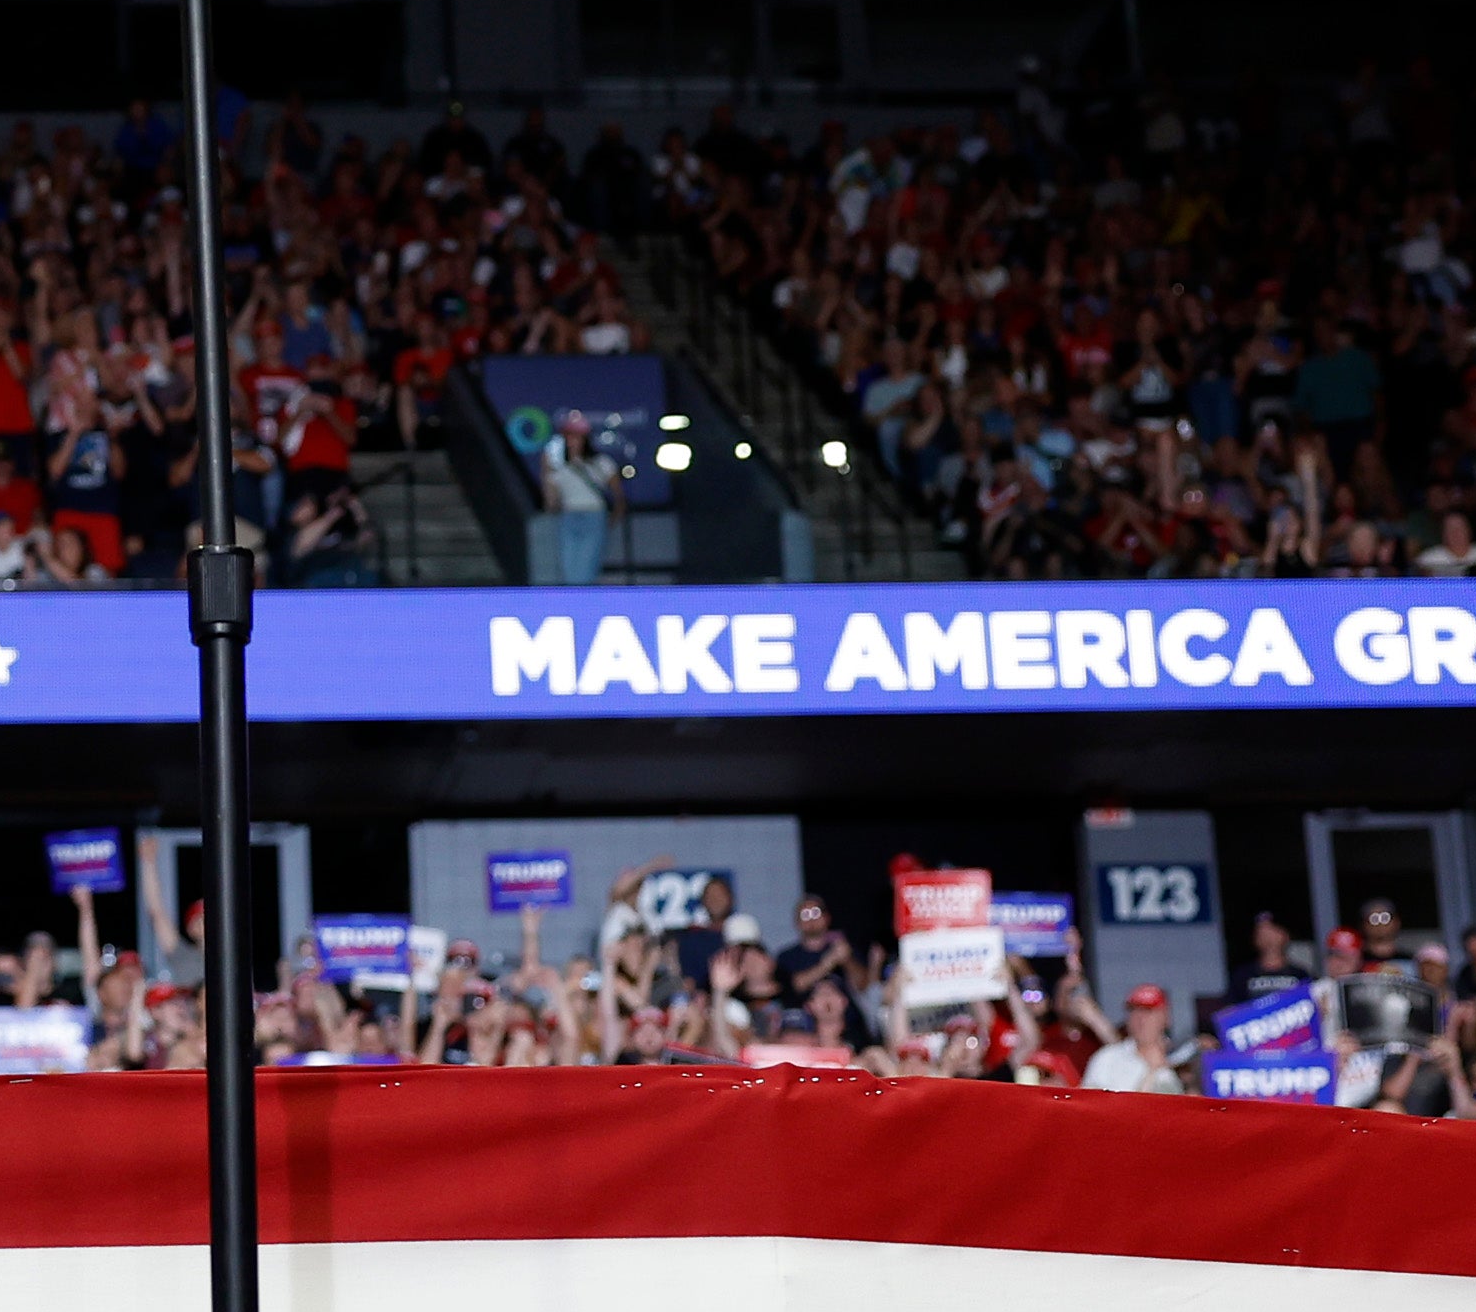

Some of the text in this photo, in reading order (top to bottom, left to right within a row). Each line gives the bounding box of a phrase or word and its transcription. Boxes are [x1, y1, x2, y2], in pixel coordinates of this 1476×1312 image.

[488, 613, 801, 697] MAKE
[823, 607, 1315, 692] AMERICA
[1107, 866, 1200, 921] 123
[1226, 999, 1316, 1053] TRUMP
[1211, 1065, 1331, 1098] TRUMP
